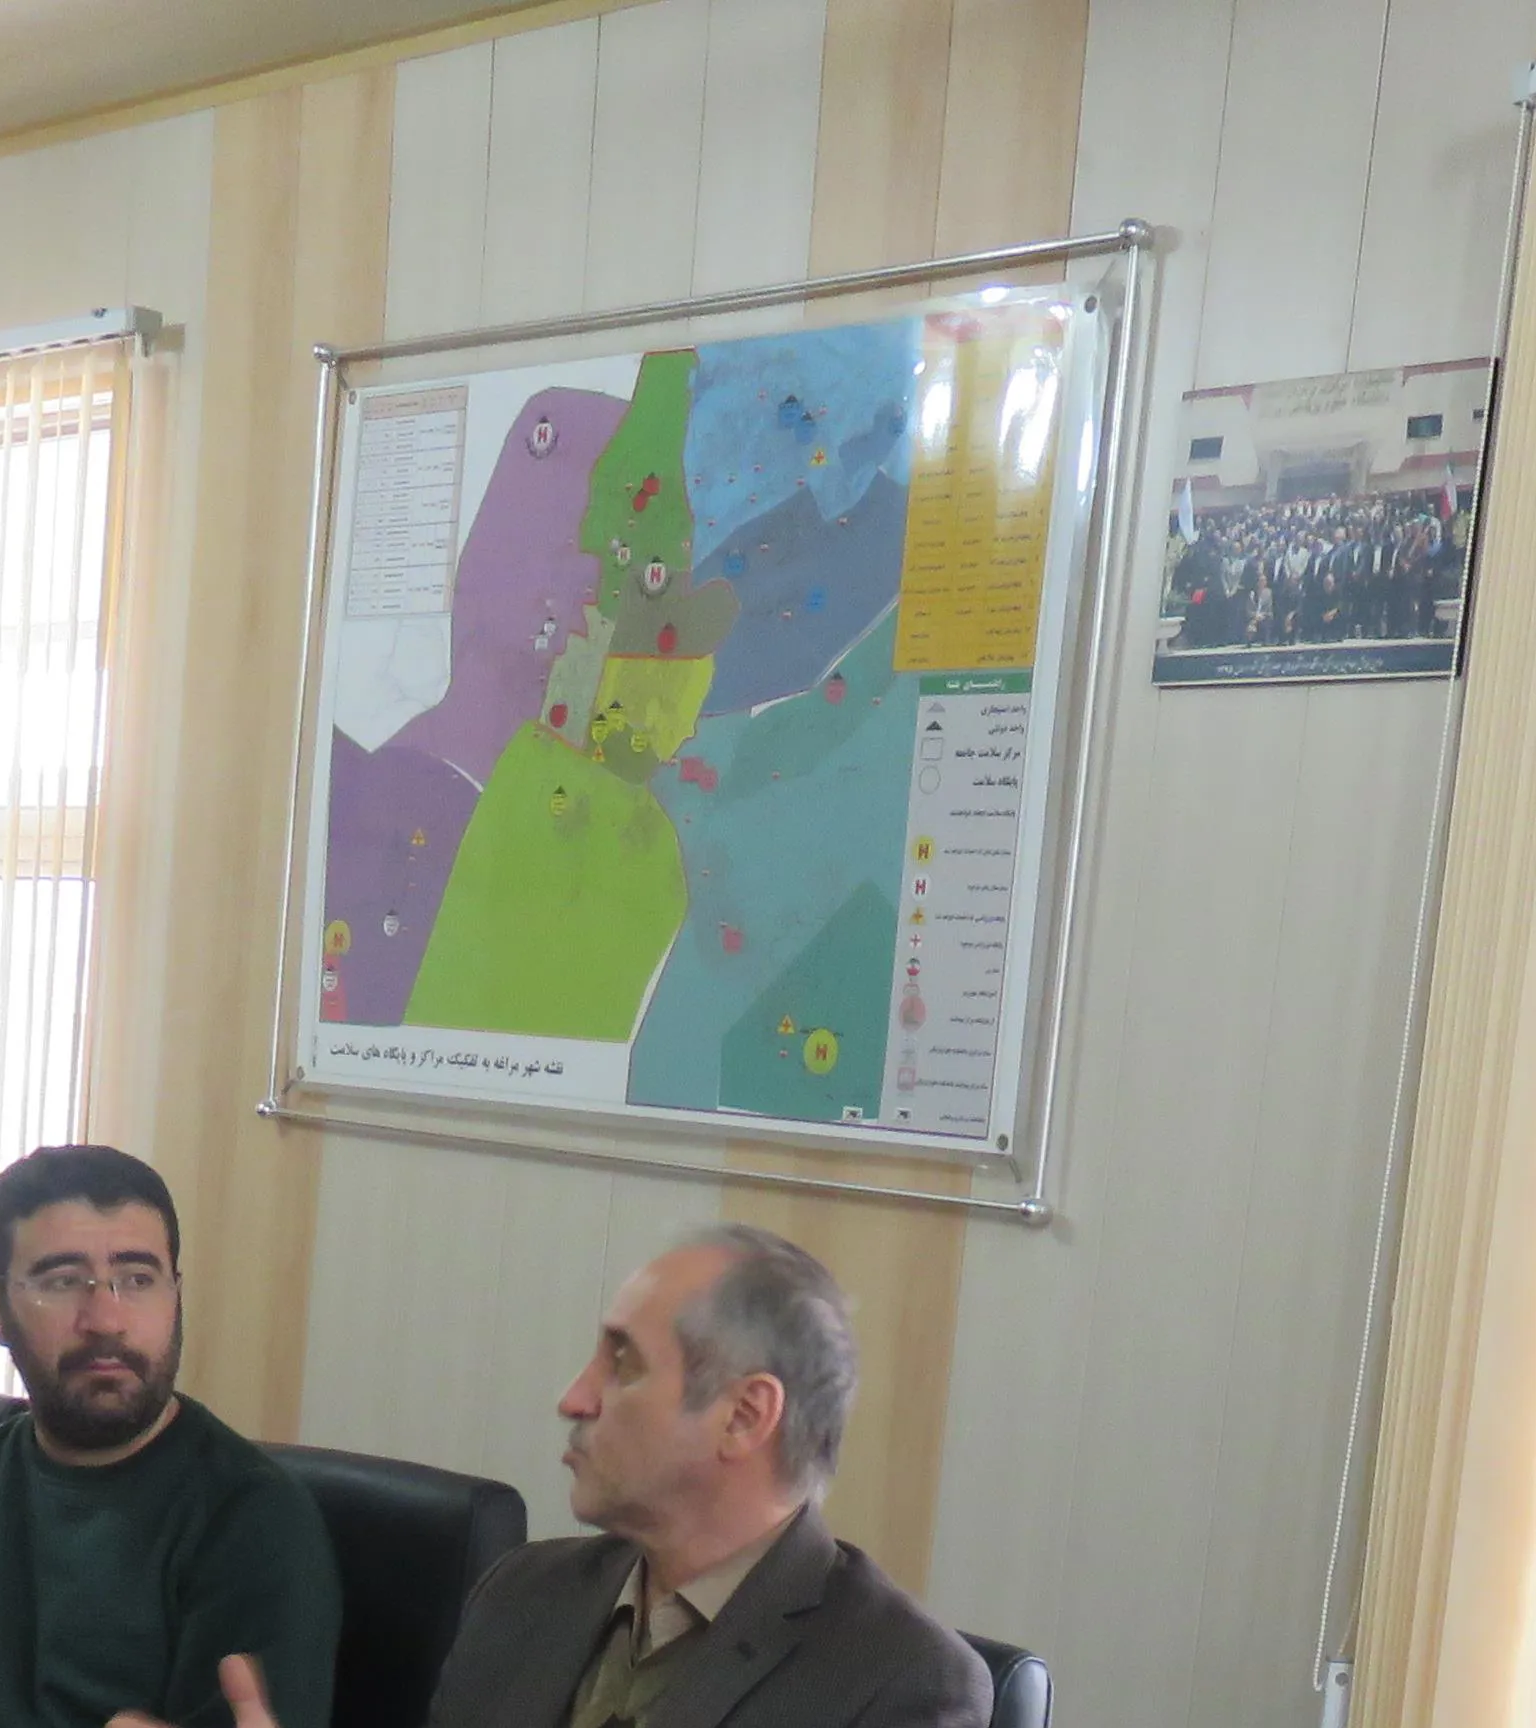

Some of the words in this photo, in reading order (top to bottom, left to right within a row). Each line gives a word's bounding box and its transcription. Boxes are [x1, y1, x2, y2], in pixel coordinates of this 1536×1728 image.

[978, 746, 1001, 758] سلامت
[1003, 746, 1021, 761] مرکز
[972, 772, 995, 786] سلامت
[330, 1042, 359, 1056] سلامت
[361, 1043, 381, 1061] های
[383, 1046, 407, 1064] پایگاه
[418, 1049, 444, 1069] مراکز
[447, 1051, 478, 1070] تفکیک
[481, 1055, 491, 1072] به
[493, 1054, 519, 1075] مراغه
[543, 1059, 564, 1075] نقشه
[522, 1059, 540, 1077] شهر
